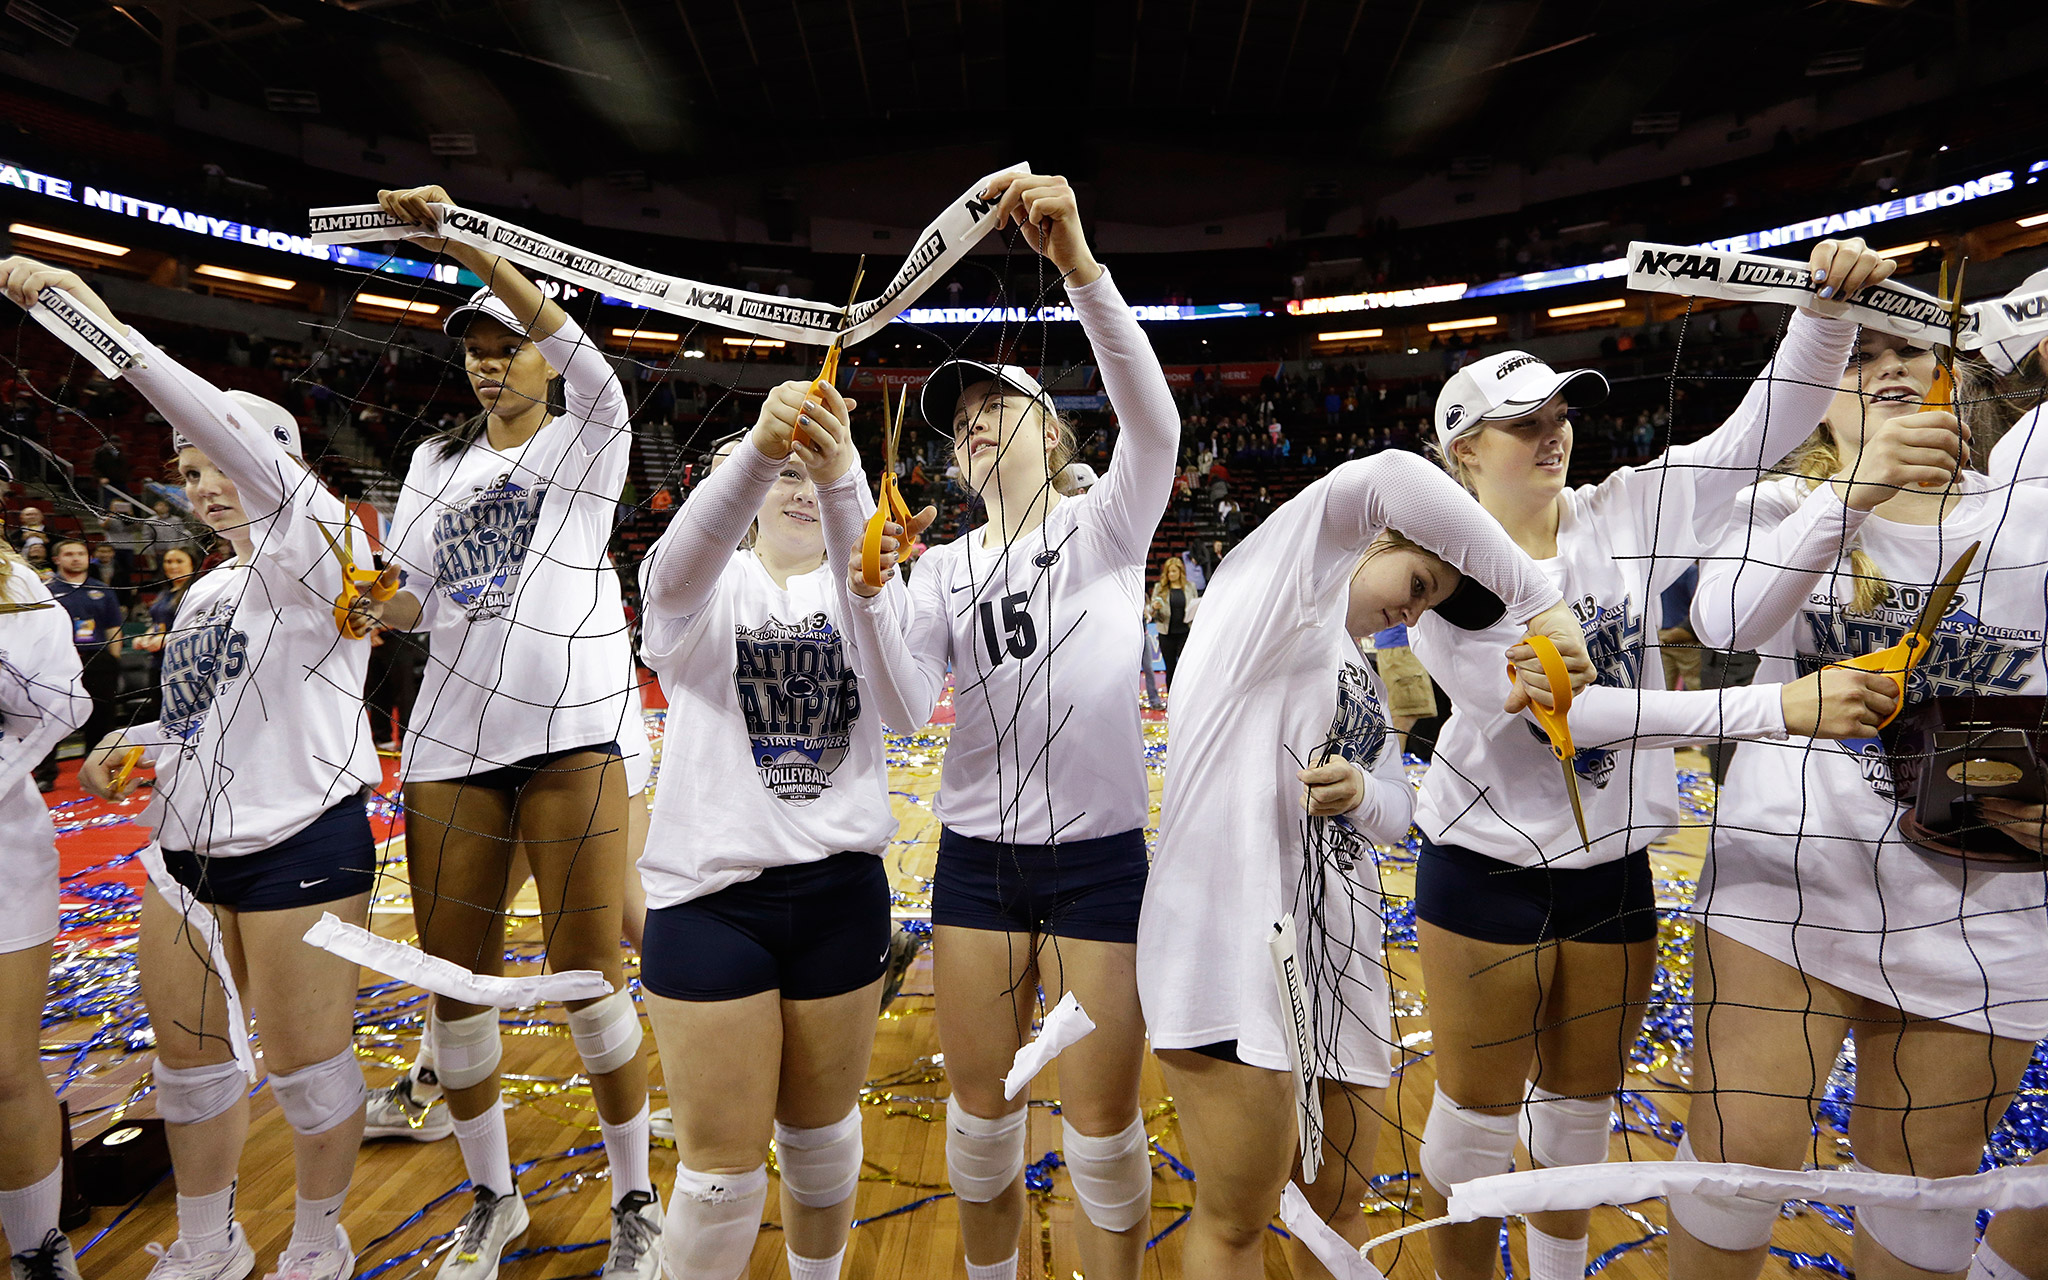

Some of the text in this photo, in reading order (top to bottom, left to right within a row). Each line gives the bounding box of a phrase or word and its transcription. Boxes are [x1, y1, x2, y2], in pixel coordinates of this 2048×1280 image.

[0, 164, 331, 262] ATE NITTANY LIONS
[1758, 200, 1893, 249] NITTANY
[1904, 170, 2014, 216] LIONS
[495, 228, 568, 266] VOLLEYBALL
[570, 255, 668, 296] CHAMPIONSHIP
[1635, 250, 1721, 283] NCAA
[38, 288, 114, 359] VOLLEYBALL
[685, 287, 736, 315] NCAA
[741, 300, 832, 328] VOLLEYBALL
[909, 307, 1034, 323] NATIONAL
[980, 591, 1037, 666] 15
[1968, 623, 2042, 642] VOLLEYBALL
[761, 736, 798, 749] STATE
[761, 767, 833, 788] VOLLEYBALL
[773, 783, 823, 795] CHAMPIONSHIP
[1285, 957, 1312, 1084] CHAMPIONSHIP
